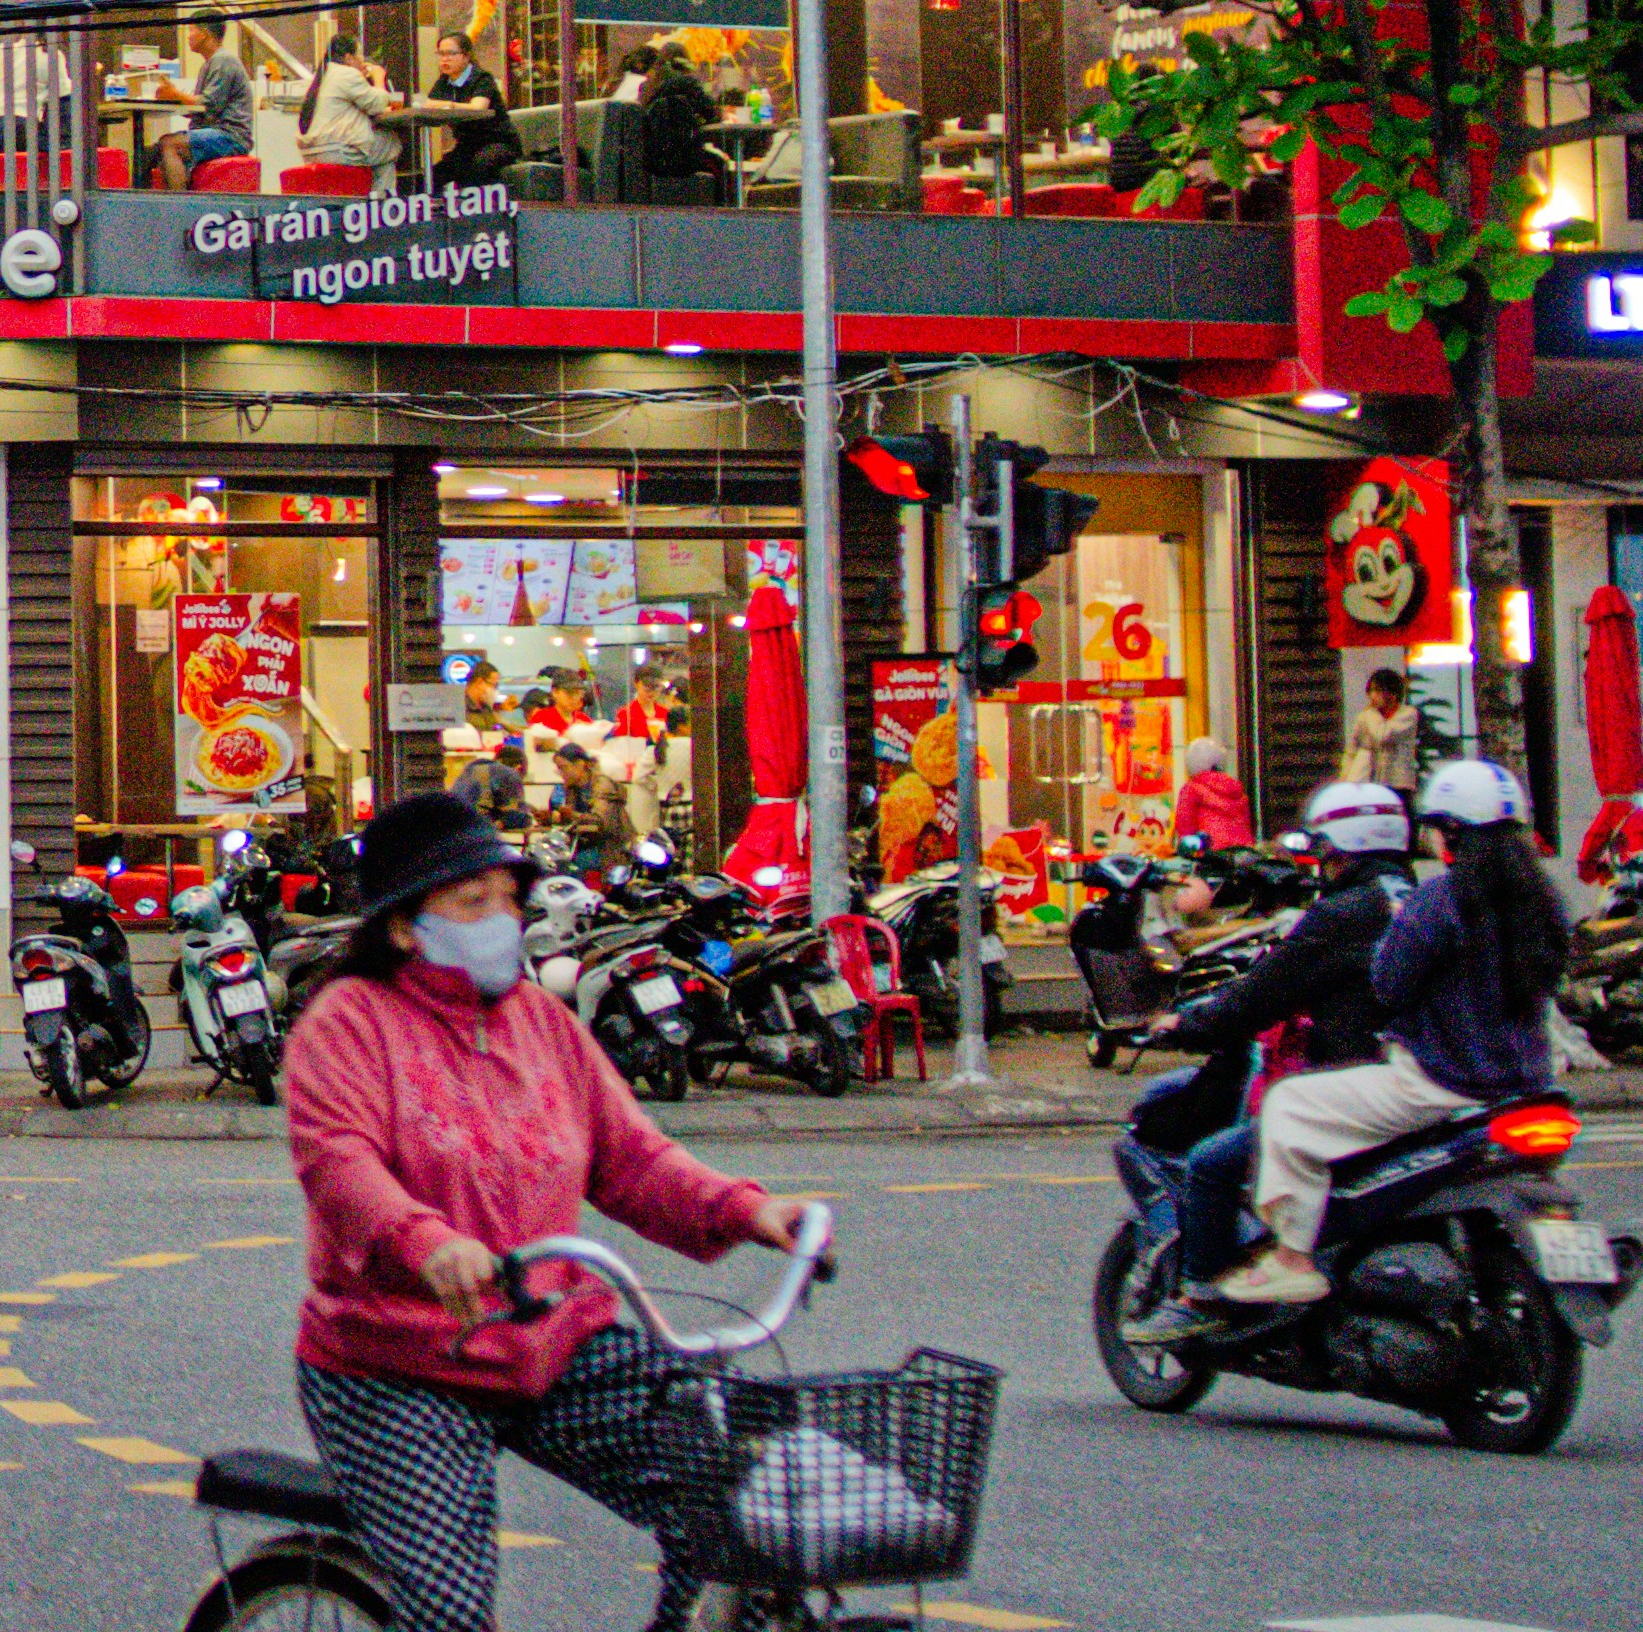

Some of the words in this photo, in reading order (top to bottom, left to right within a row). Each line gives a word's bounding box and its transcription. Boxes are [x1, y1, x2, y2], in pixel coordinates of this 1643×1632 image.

[193, 210, 252, 253] Gà
[266, 201, 330, 244] rán
[342, 188, 432, 243] giòn
[444, 180, 518, 219] tan,
[292, 255, 396, 305] ngon
[407, 230, 511, 286] tuyệt
[209, 616, 246, 629] JOLLY
[246, 632, 294, 656] NGON
